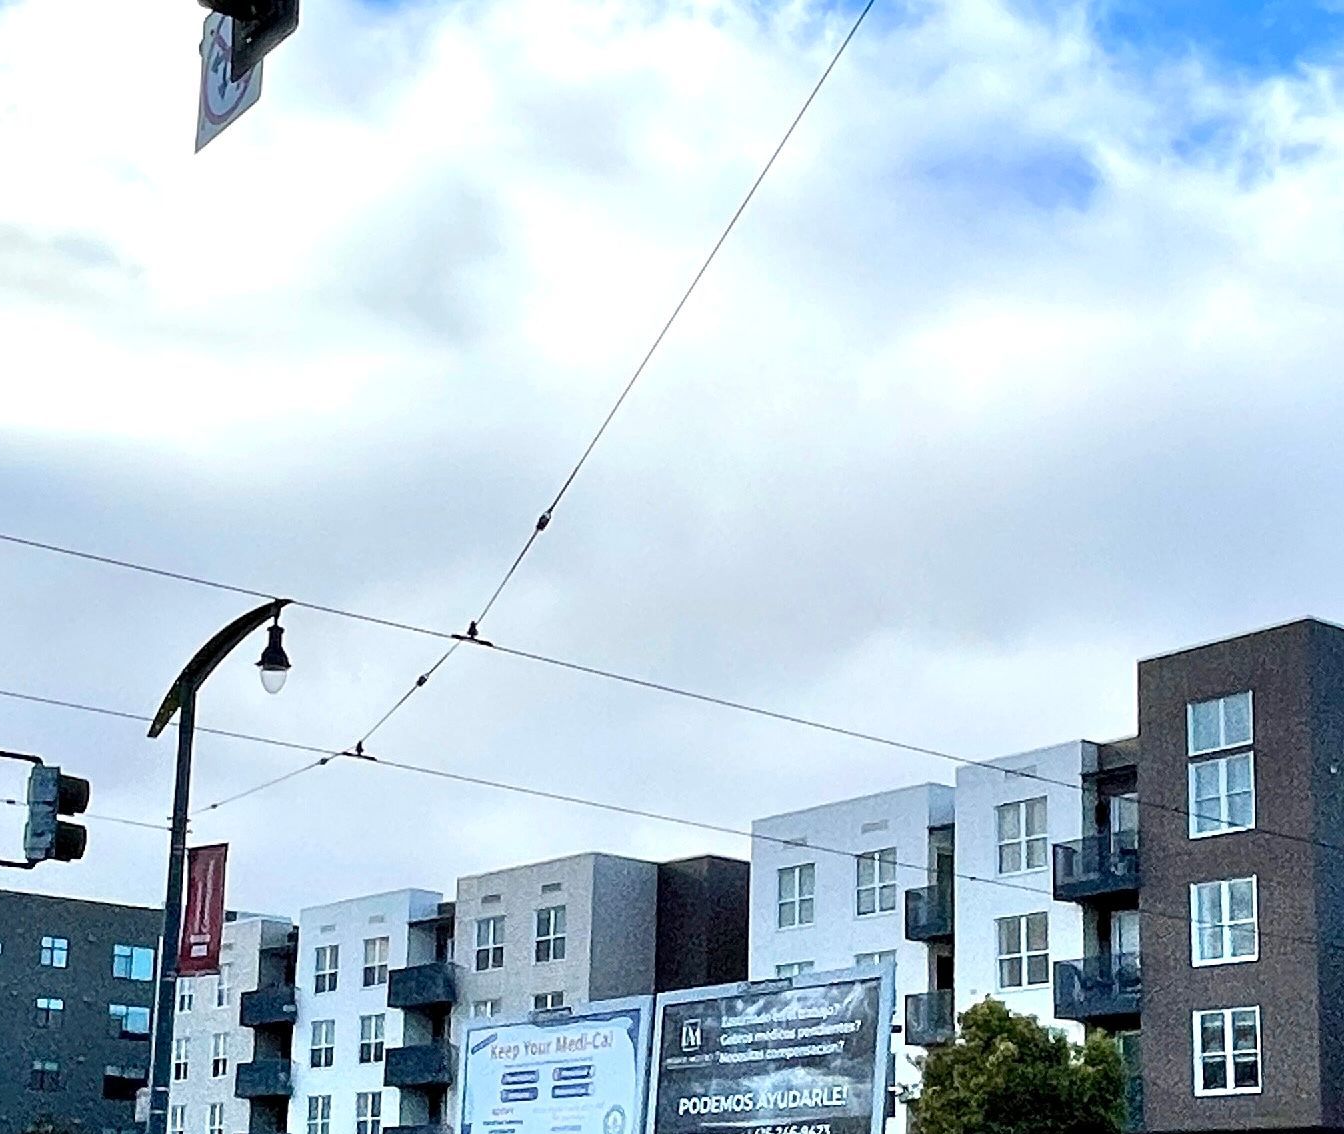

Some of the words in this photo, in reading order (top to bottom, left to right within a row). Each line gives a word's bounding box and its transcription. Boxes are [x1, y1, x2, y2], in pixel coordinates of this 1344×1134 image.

[490, 1043, 520, 1060] Keep
[524, 1040, 552, 1056] Your
[556, 1031, 614, 1053] Medi-Cal
[678, 1093, 754, 1116] PODEMOS
[755, 1085, 848, 1110] AYUDARLE!
